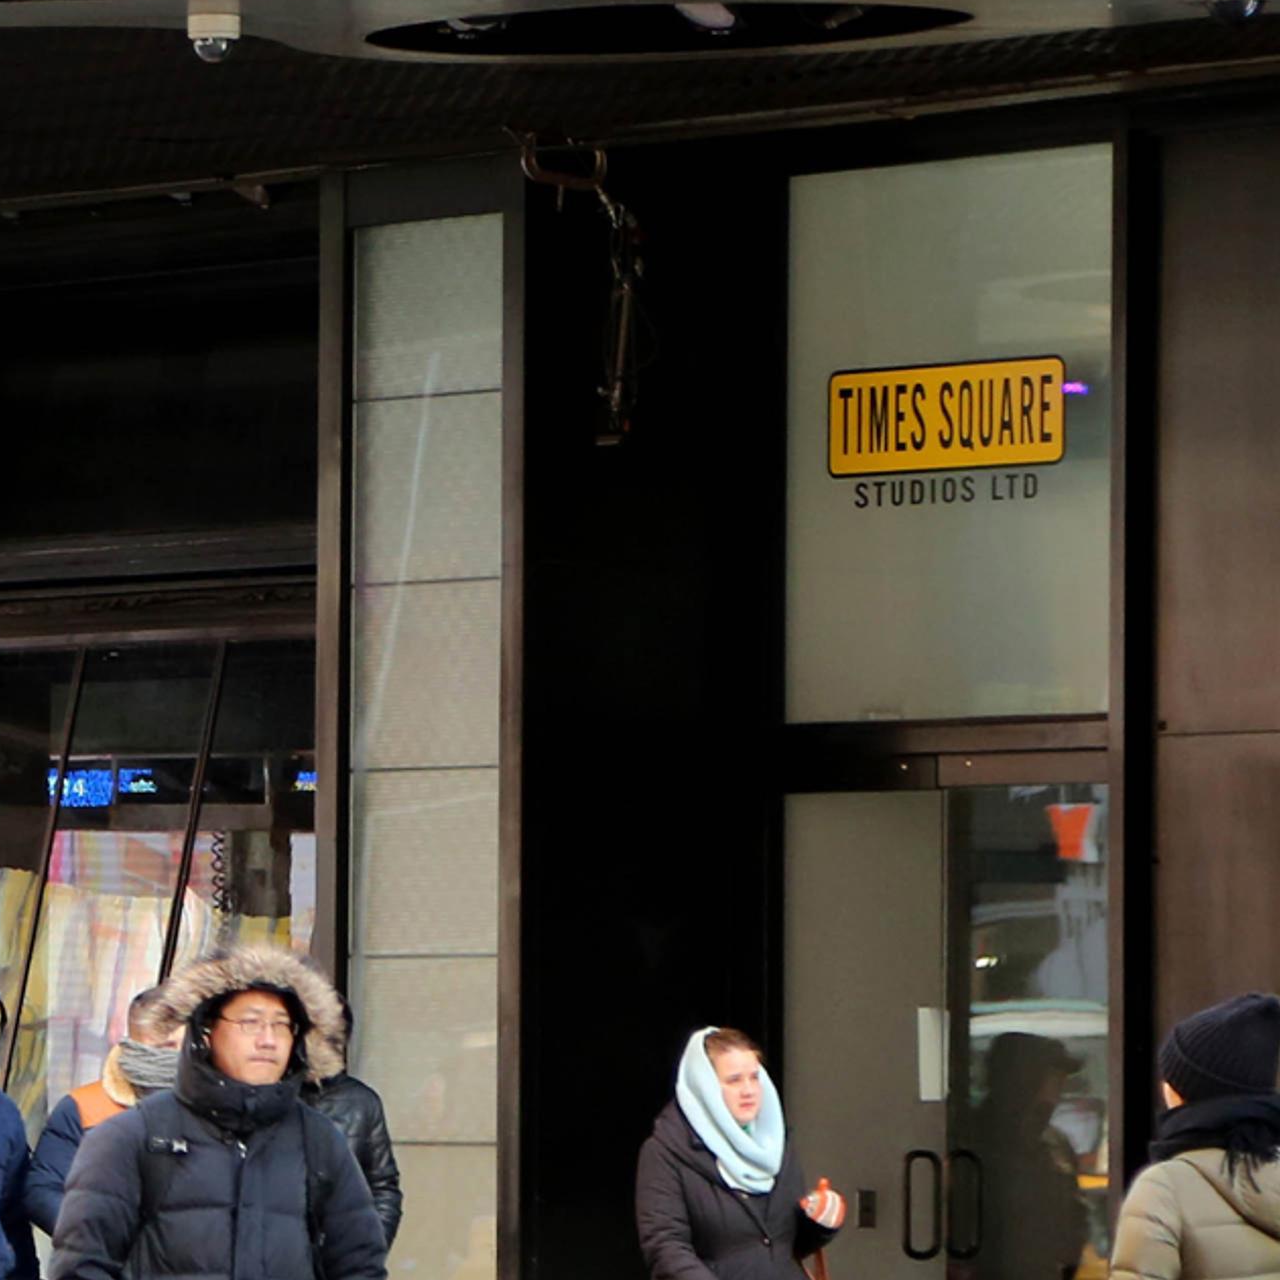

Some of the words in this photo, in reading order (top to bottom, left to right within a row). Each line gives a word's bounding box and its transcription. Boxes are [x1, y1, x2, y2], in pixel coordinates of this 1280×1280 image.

[838, 383, 927, 456] TIMES
[937, 374, 1054, 452] SQUARE
[854, 475, 976, 509] STUDIOS
[991, 472, 1039, 501] LTD
